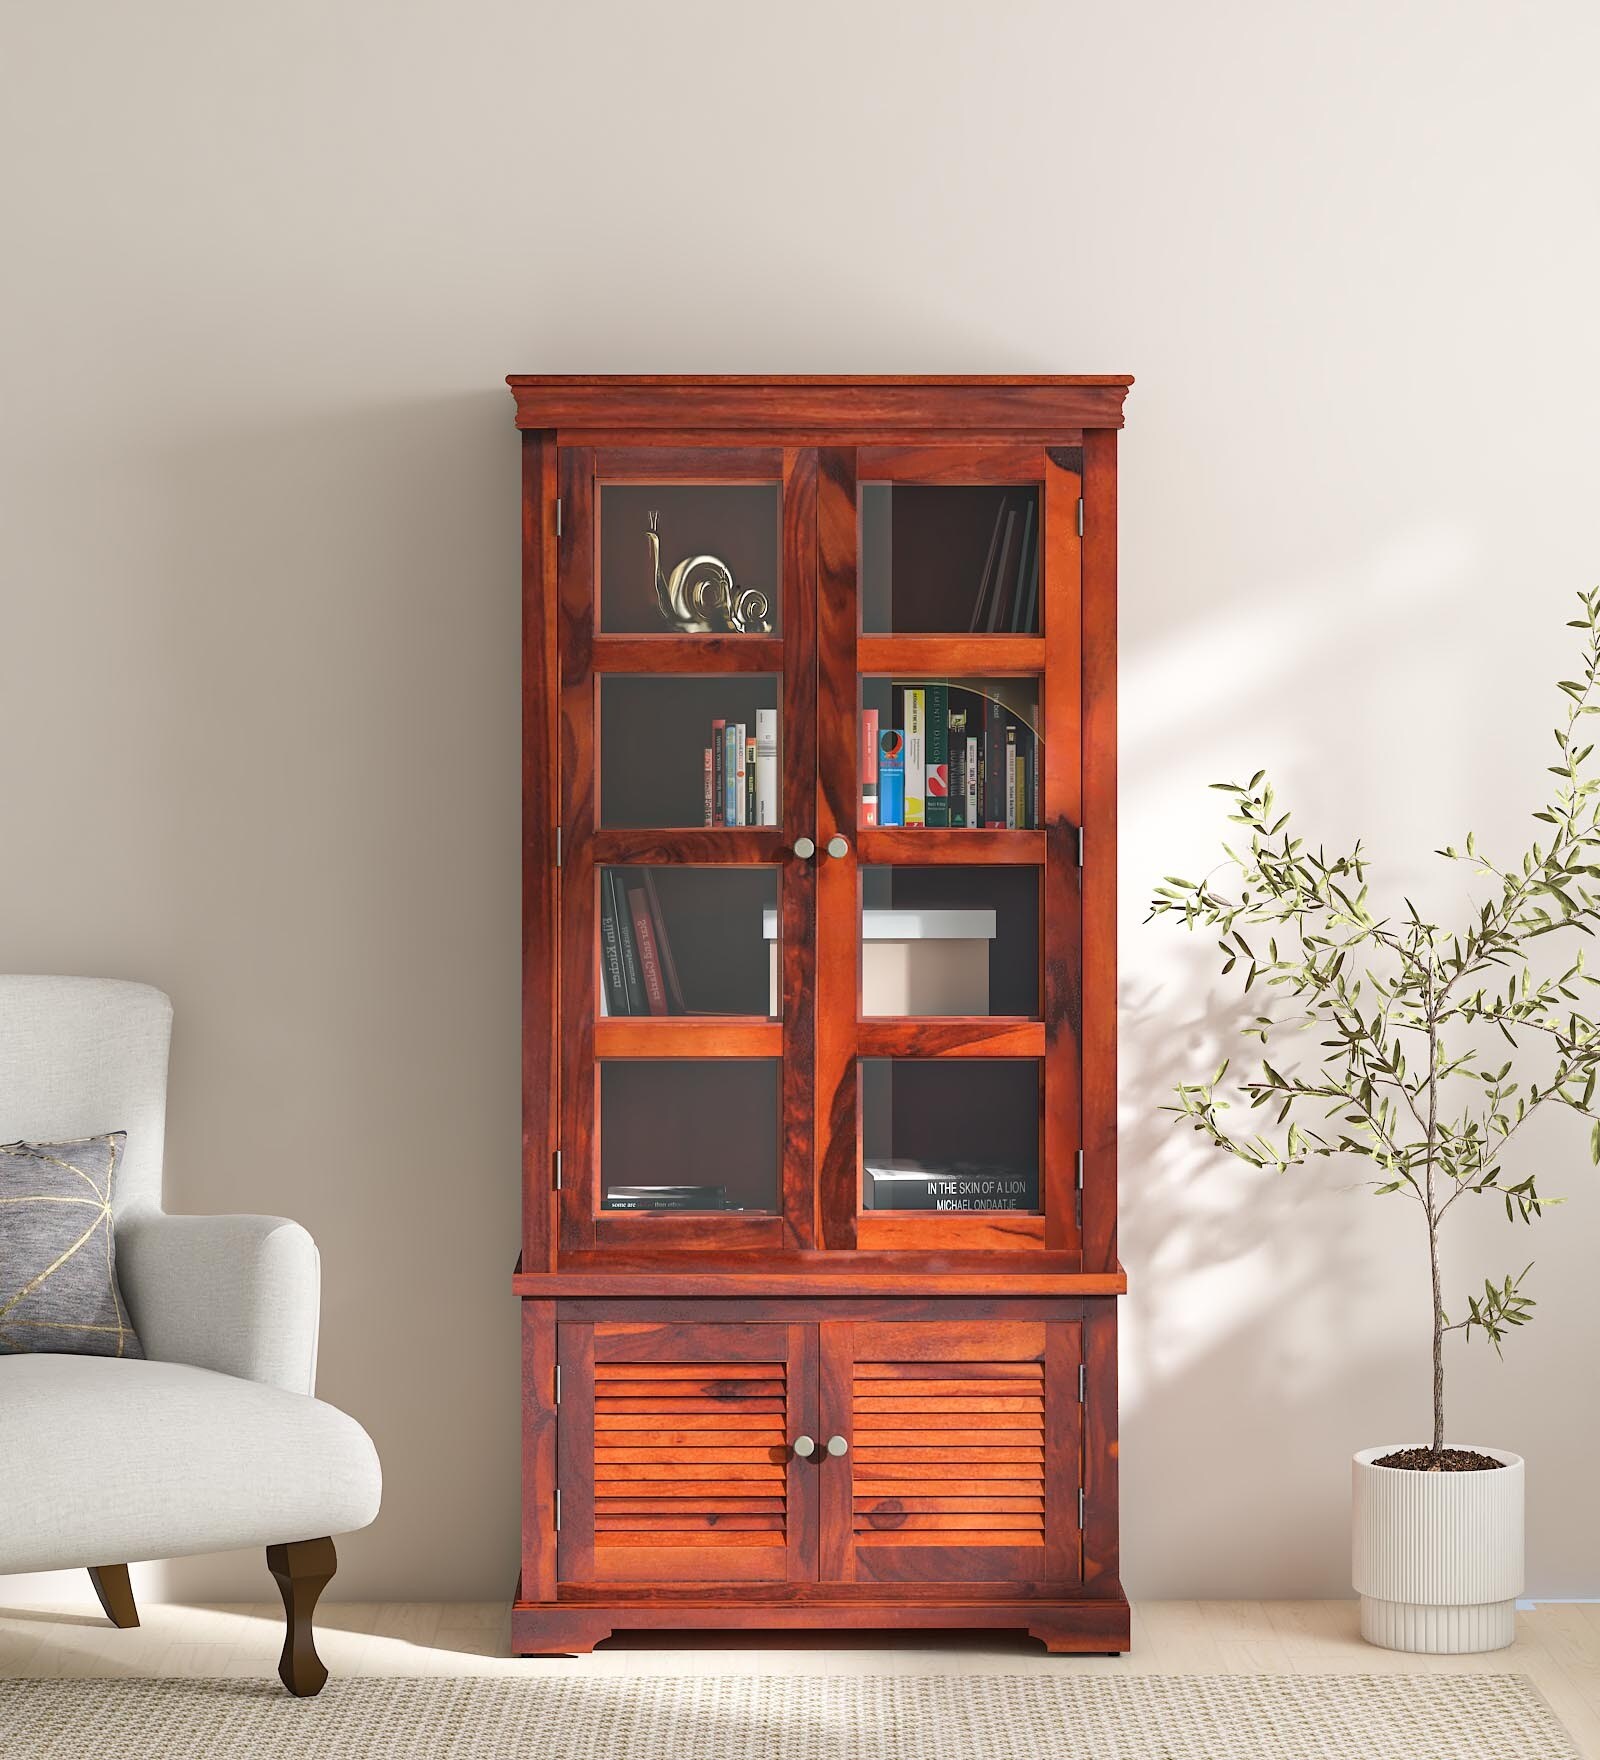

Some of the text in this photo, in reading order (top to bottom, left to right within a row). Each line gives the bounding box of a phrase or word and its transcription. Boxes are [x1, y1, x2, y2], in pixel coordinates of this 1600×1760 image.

[928, 1181, 1026, 1194] IN THE SKIN OF A LION
[936, 1199, 1017, 1210] MICHAEL ONDAATJE
